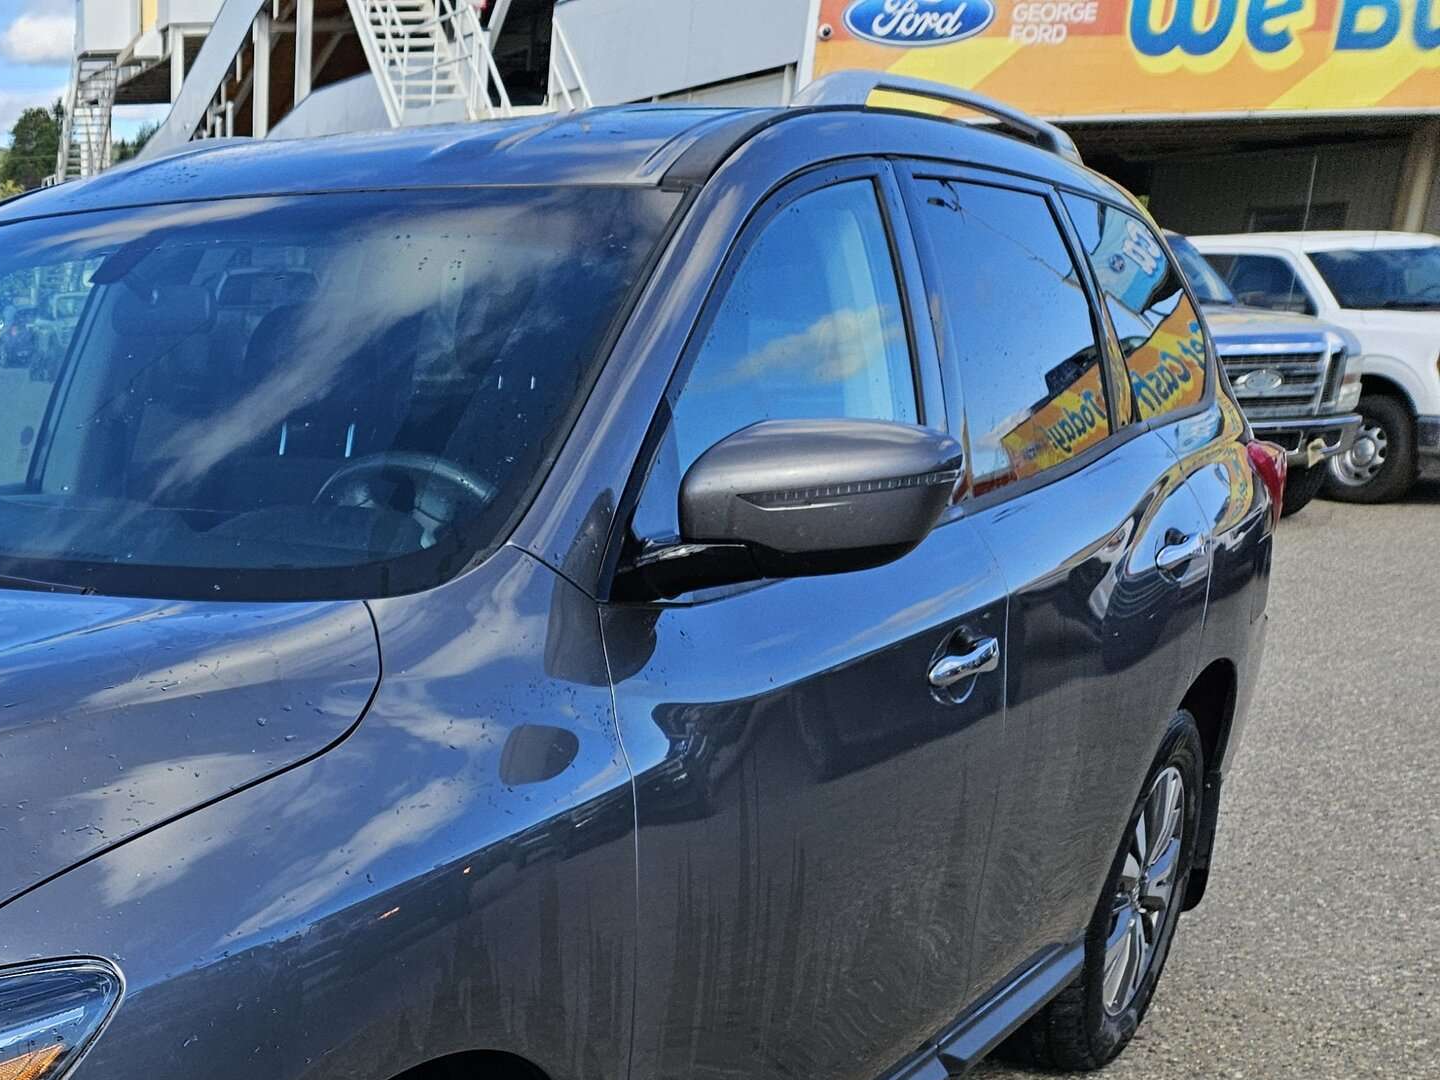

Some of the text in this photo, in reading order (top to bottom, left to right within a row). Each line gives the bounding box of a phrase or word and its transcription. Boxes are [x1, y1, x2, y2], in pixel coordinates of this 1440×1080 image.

[871, 0, 962, 37] Ford
[1012, 2, 1098, 23] GEORGE
[1009, 23, 1068, 44] FORD
